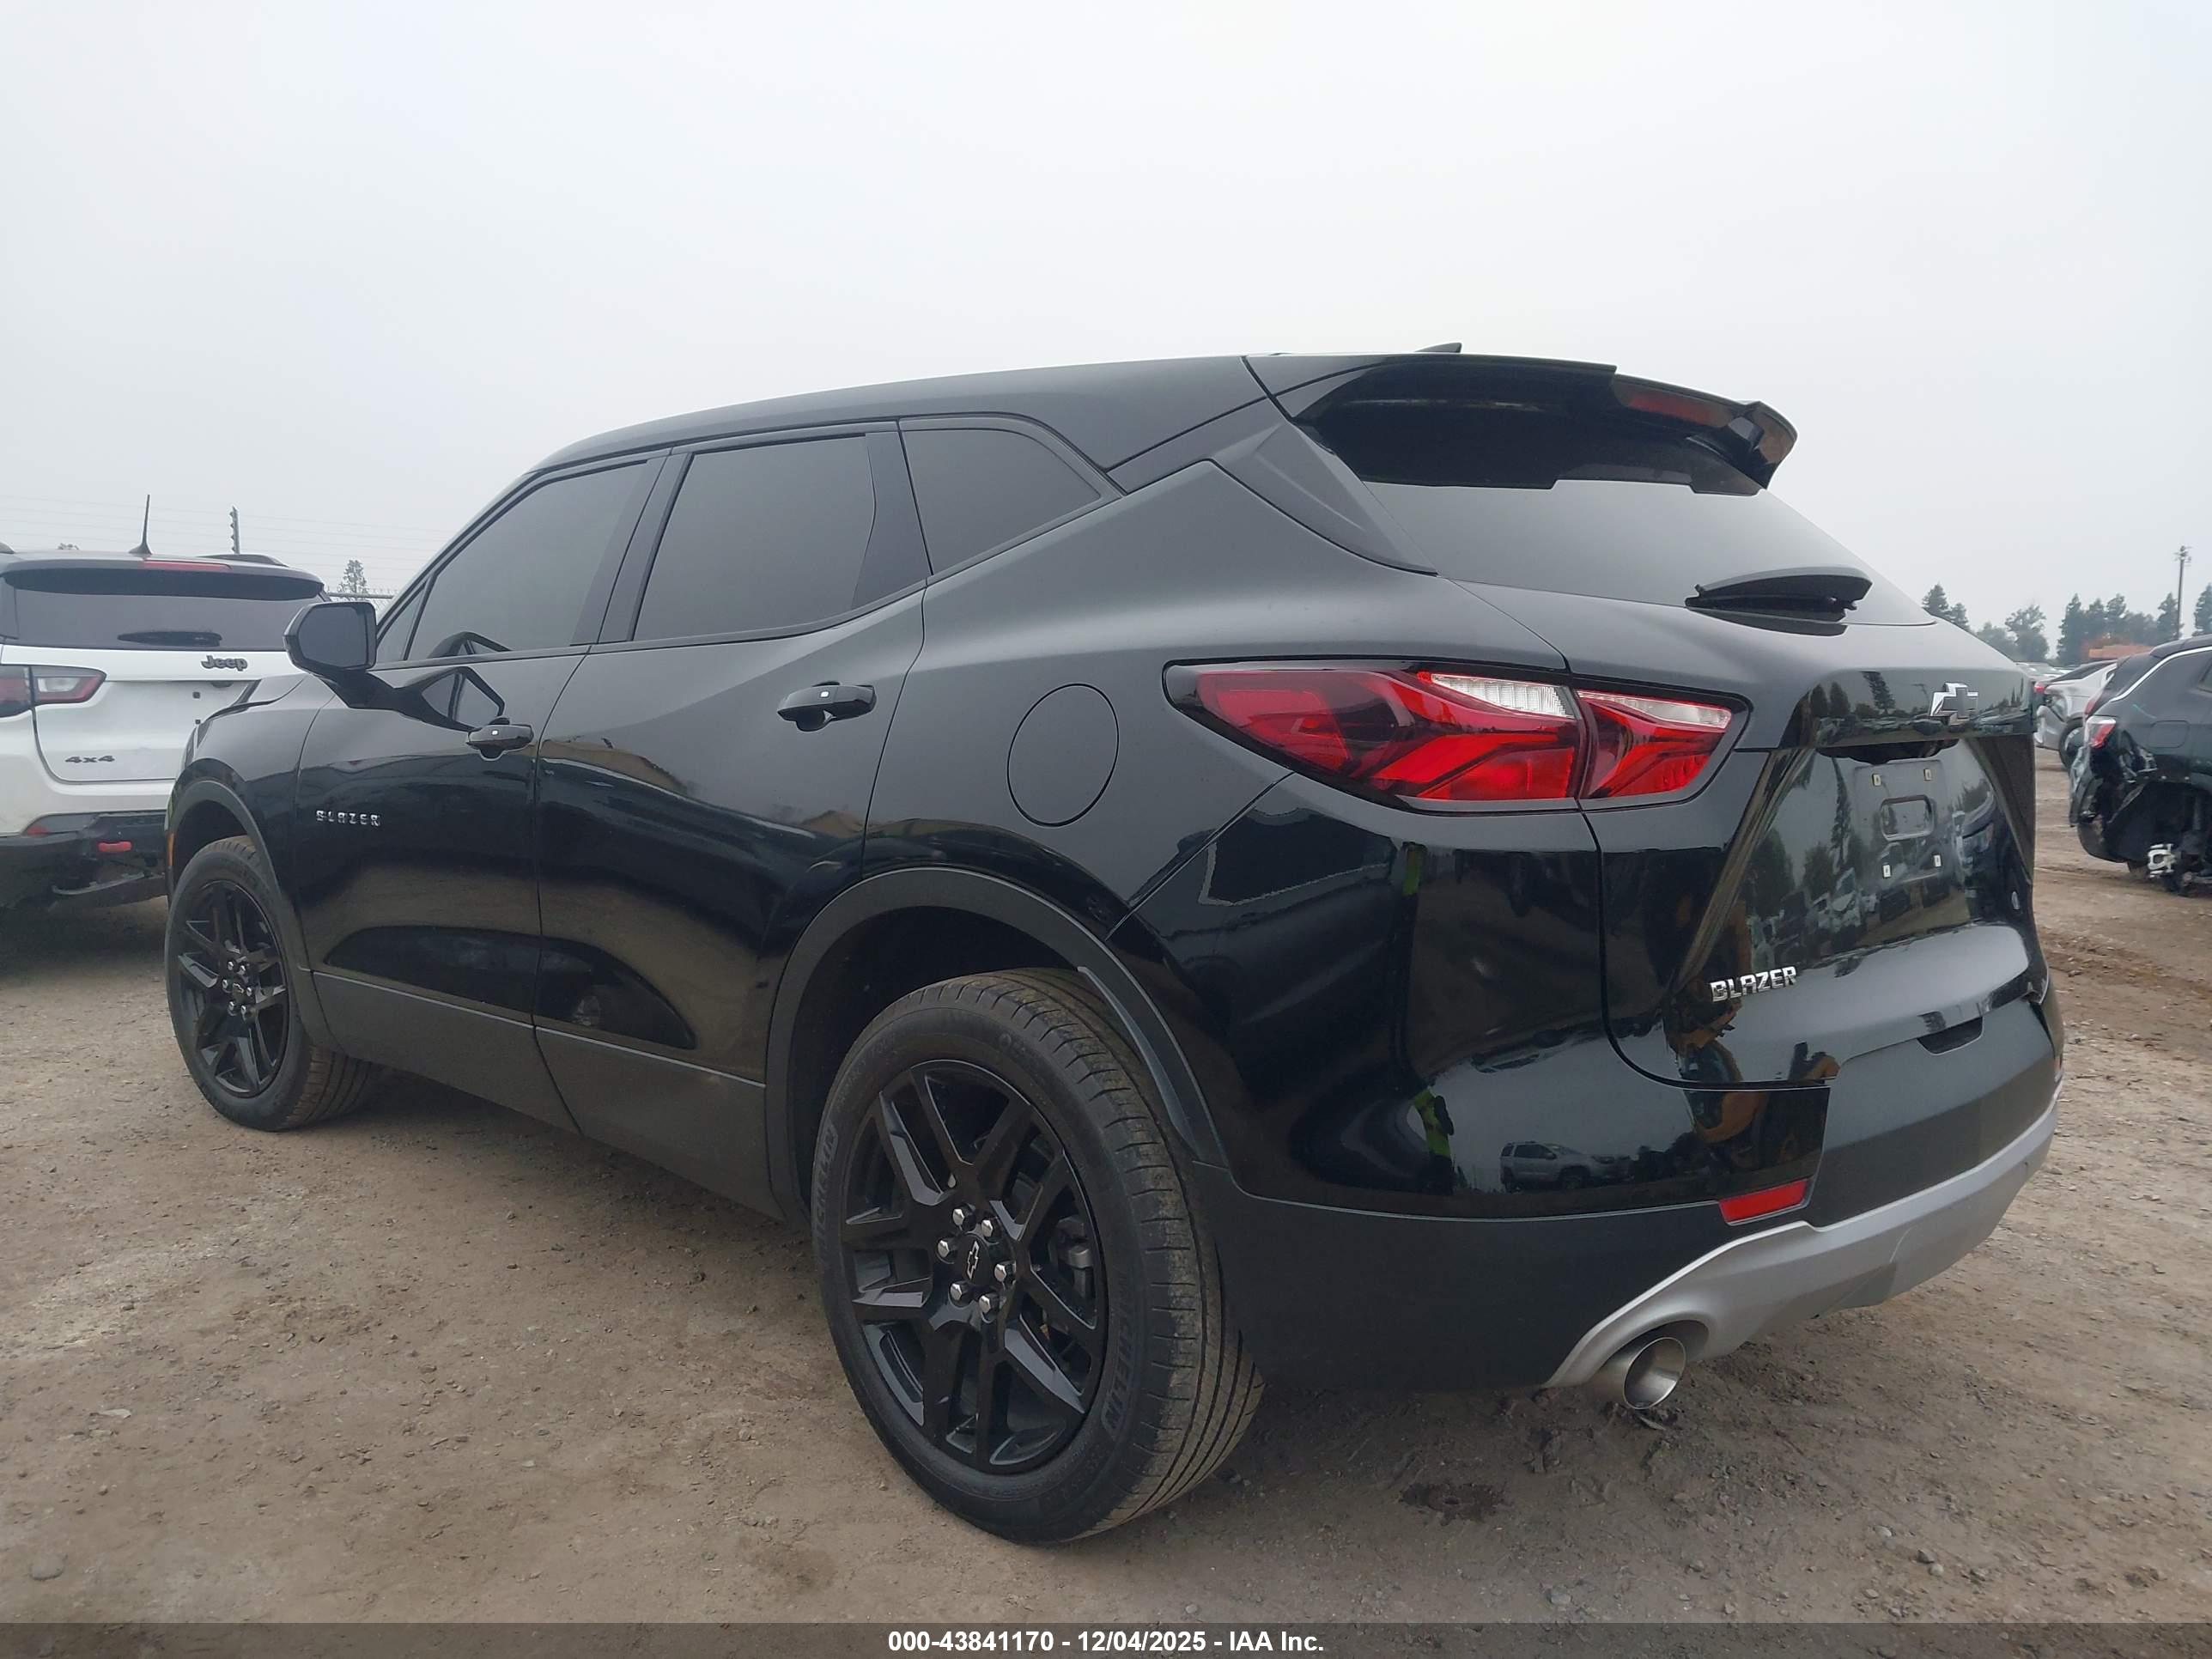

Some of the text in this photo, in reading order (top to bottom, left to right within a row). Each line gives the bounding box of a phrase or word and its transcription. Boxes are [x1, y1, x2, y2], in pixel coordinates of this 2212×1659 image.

[200, 654, 248, 672] Jeep
[64, 755, 116, 763] 4x4
[1710, 965, 1797, 1003] BLAZER
